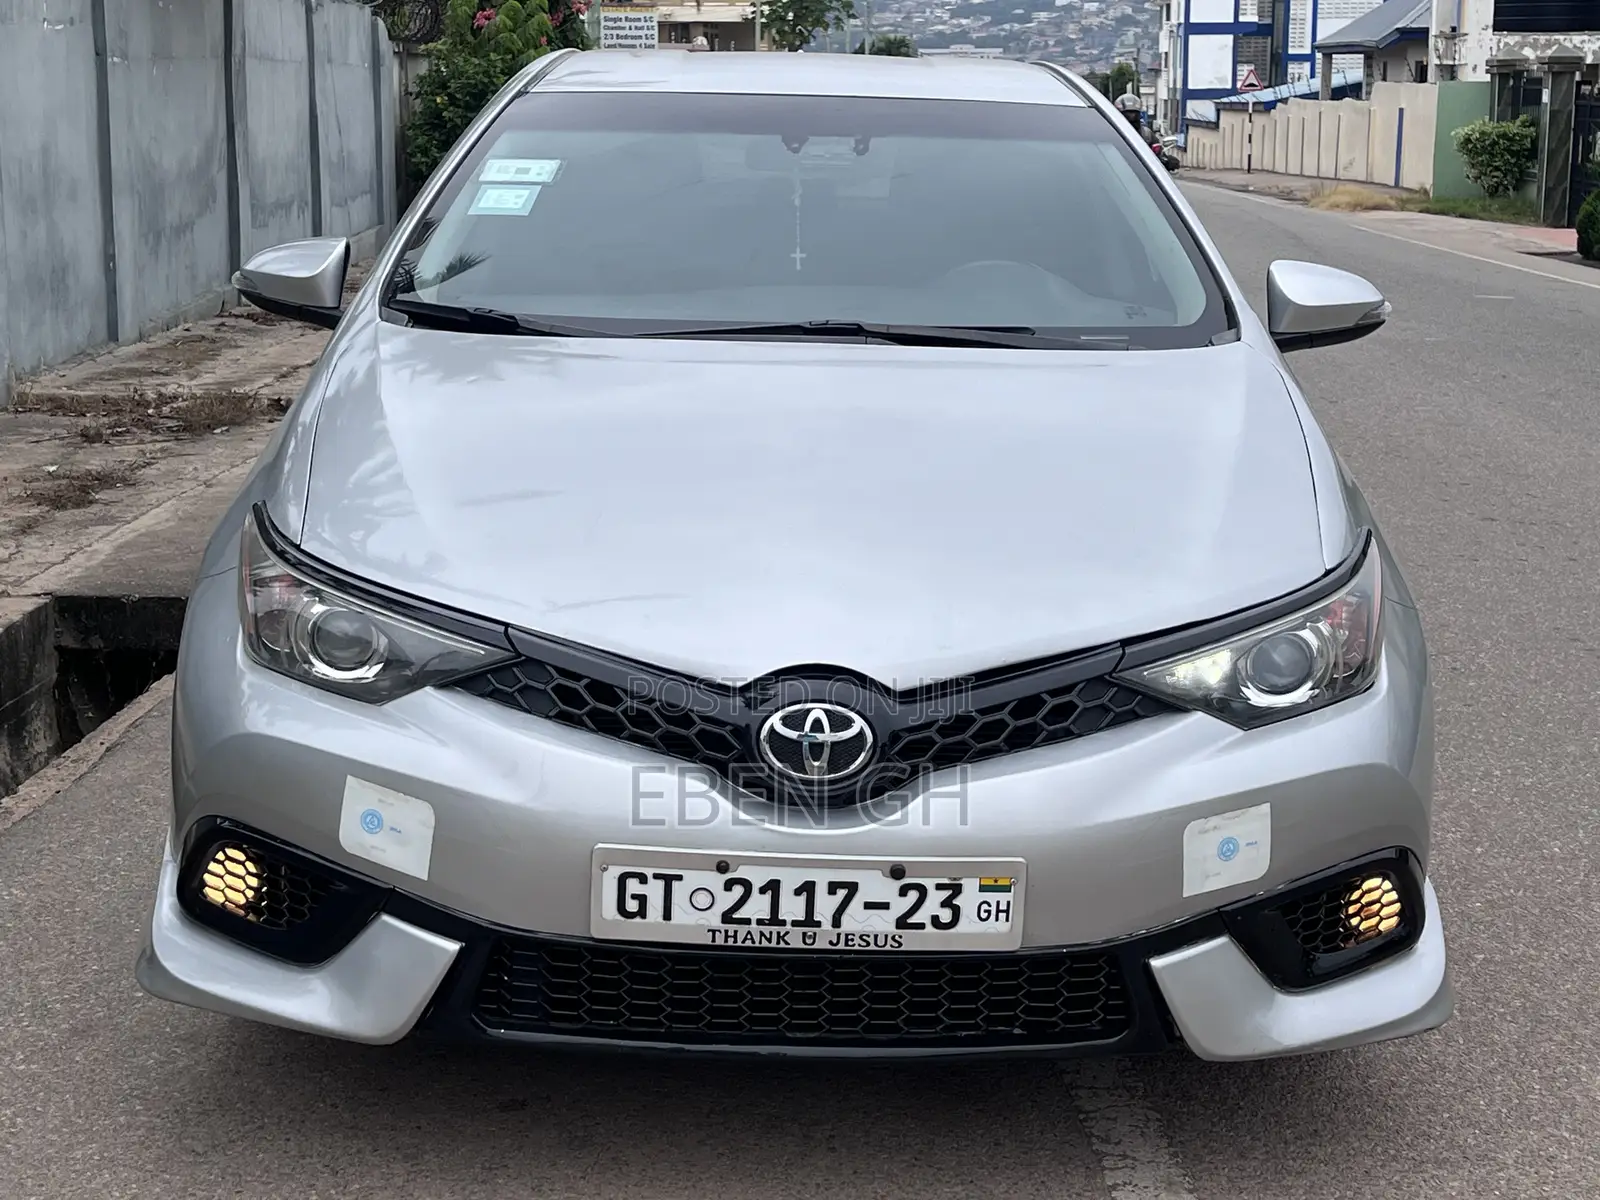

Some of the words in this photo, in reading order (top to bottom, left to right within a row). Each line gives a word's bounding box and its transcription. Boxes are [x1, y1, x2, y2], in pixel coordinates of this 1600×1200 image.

[603, 15, 623, 24] Single
[616, 871, 683, 921] GT
[720, 877, 963, 931] 2117-23
[976, 900, 1011, 923] GH
[707, 928, 791, 947] THANK
[828, 932, 904, 950] JESUS
